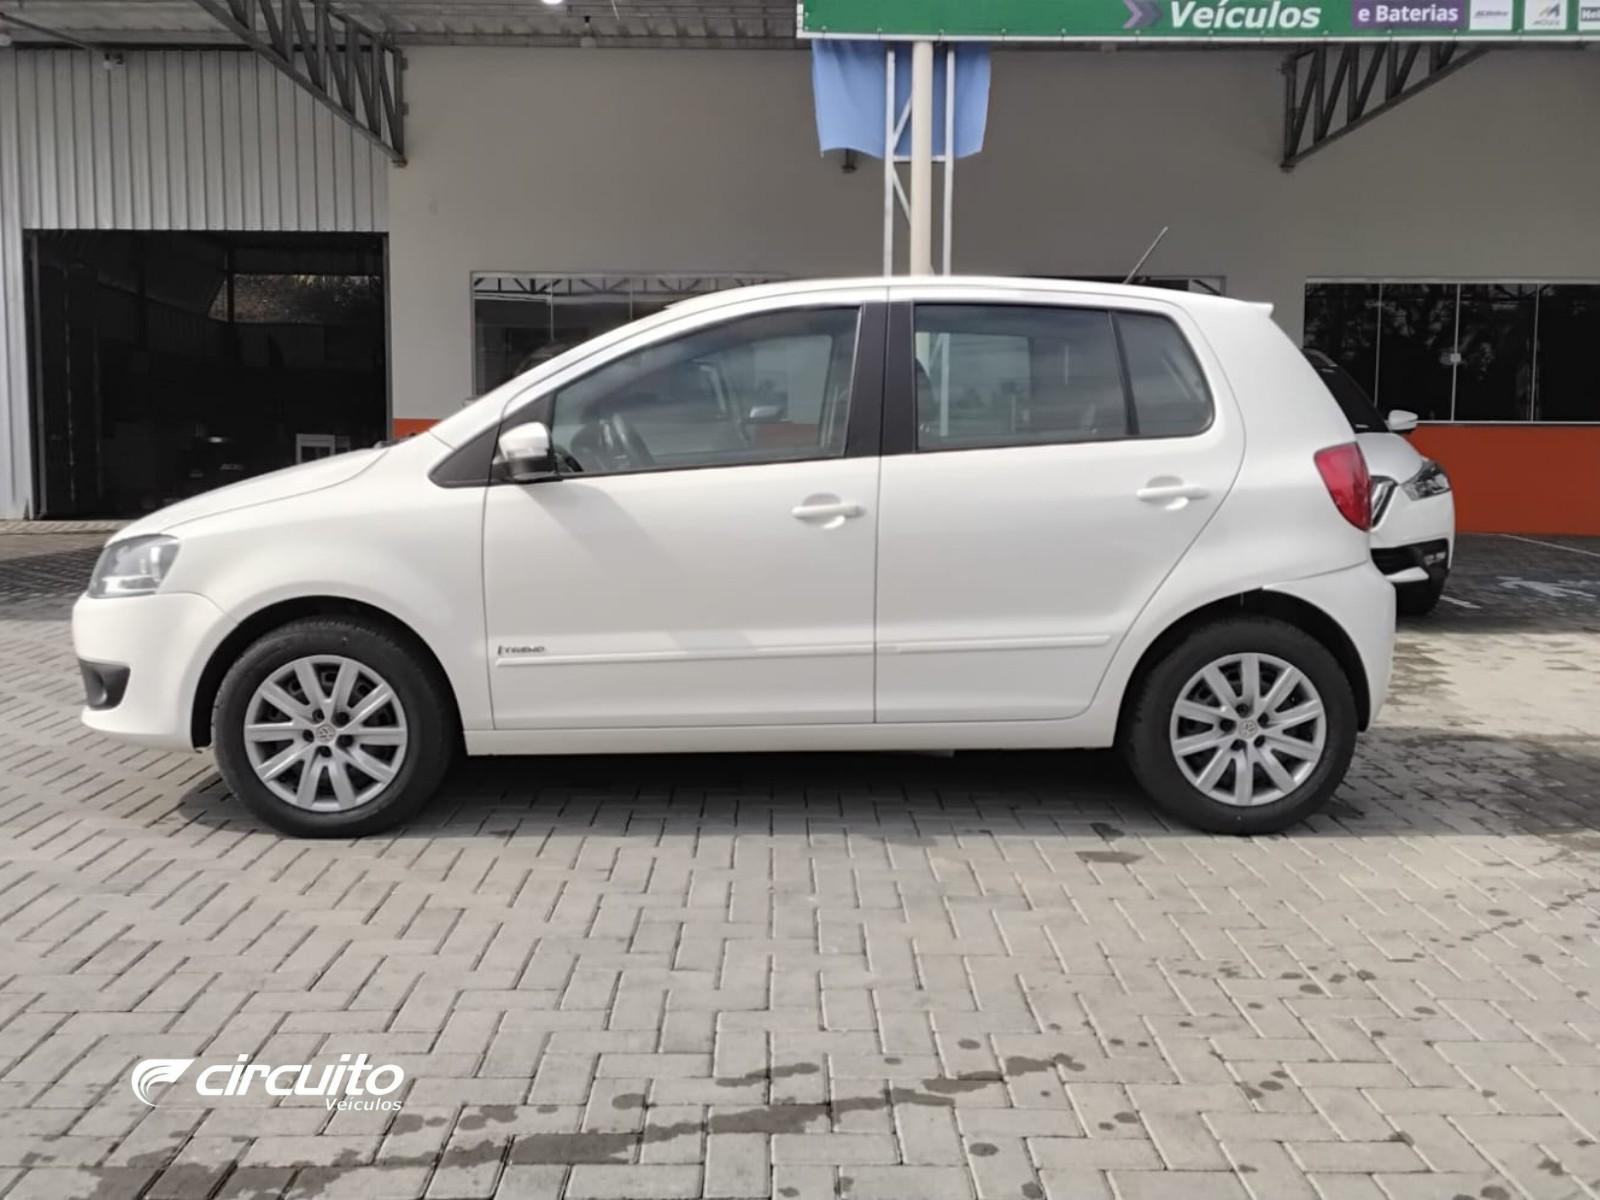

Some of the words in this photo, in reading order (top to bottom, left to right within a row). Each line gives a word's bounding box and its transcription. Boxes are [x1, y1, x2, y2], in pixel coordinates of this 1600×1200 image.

[1170, 0, 1321, 28] Veículos
[1357, 9, 1370, 22] e
[1376, 5, 1458, 22] Baterias
